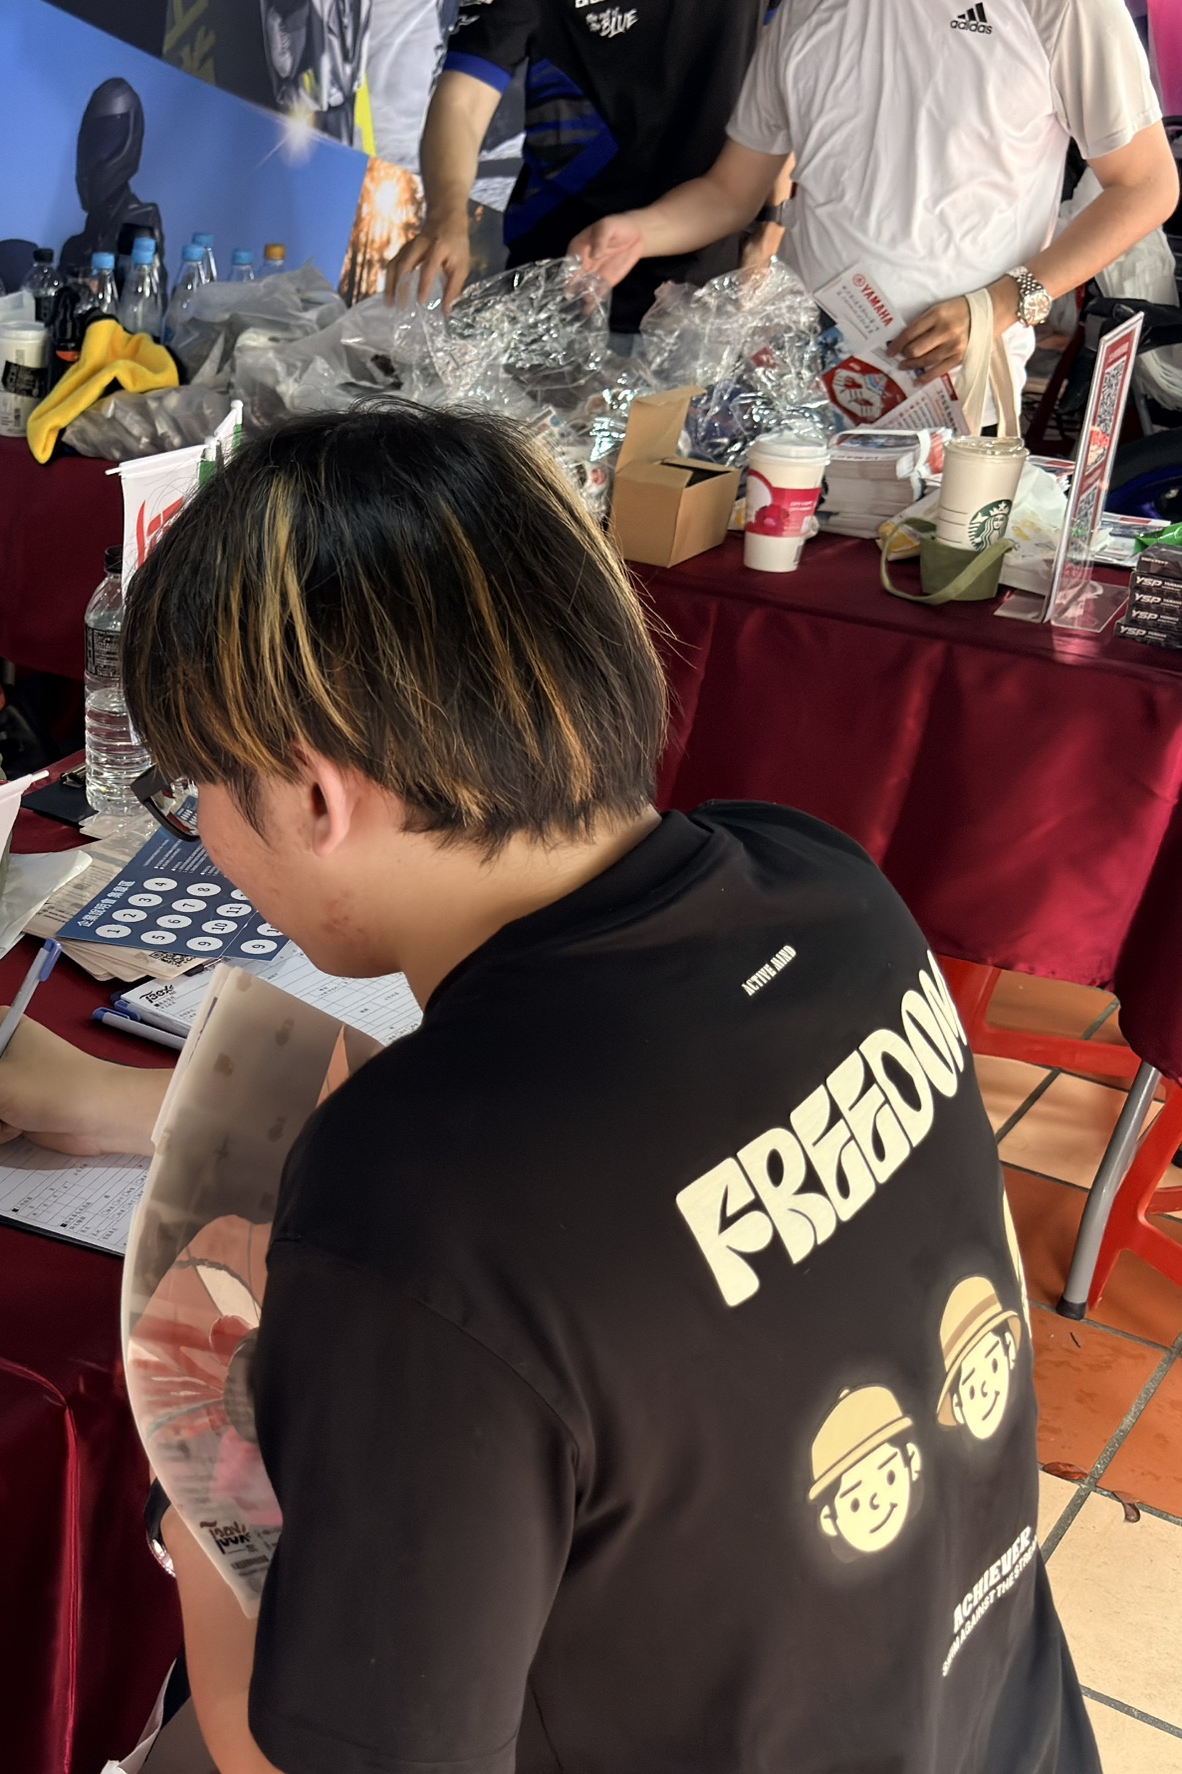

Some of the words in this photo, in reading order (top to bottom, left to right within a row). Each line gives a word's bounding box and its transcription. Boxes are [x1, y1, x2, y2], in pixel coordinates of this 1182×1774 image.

[599, 6, 638, 38] BLUE
[950, 20, 992, 34] adidas
[861, 283, 894, 327] YAMAHA
[1136, 576, 1162, 587] YSP
[1134, 593, 1161, 604] YSP
[1131, 610, 1158, 620] YSP
[1120, 626, 1147, 636] YSP
[741, 964, 776, 996] ACTIVE
[770, 945, 796, 971] MIND
[954, 1526, 1032, 1634] ACHIEVER
